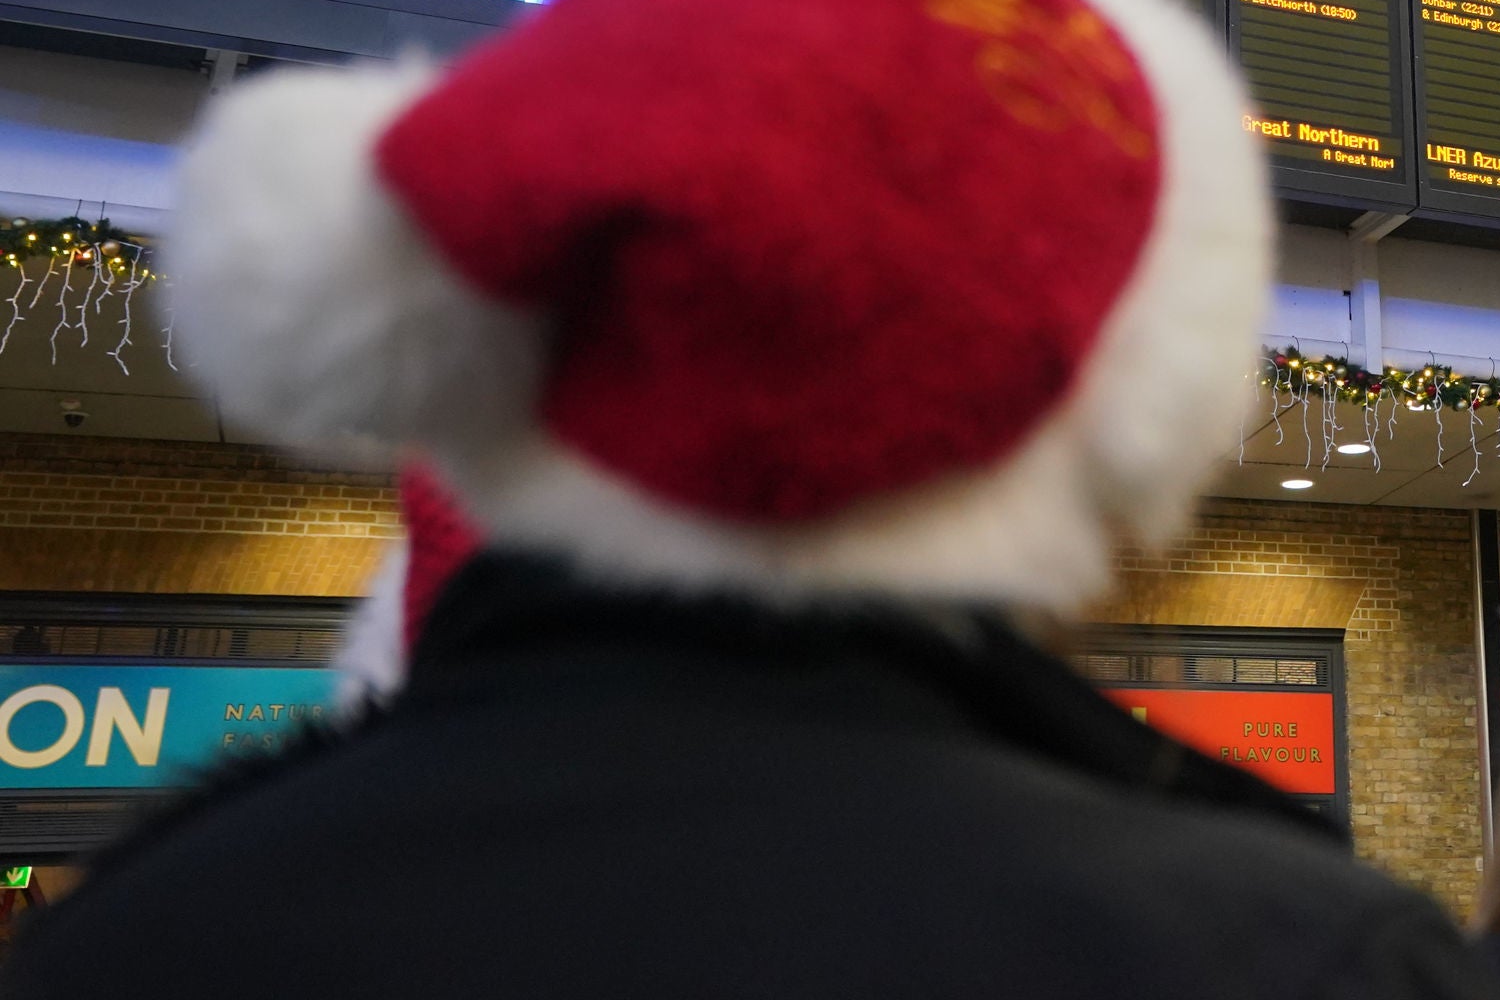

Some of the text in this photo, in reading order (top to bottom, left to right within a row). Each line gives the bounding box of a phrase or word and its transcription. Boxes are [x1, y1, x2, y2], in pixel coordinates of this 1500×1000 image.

[1298, 123, 1379, 152] Northern
[1426, 143, 1466, 165] LNER
[1448, 168, 1493, 185] Reserve
[224, 703, 324, 722] NATUR
[0, 684, 171, 769] ON
[1243, 722, 1298, 738] PURE
[223, 732, 288, 750] FAS
[1220, 747, 1322, 763] FLAVOUR
